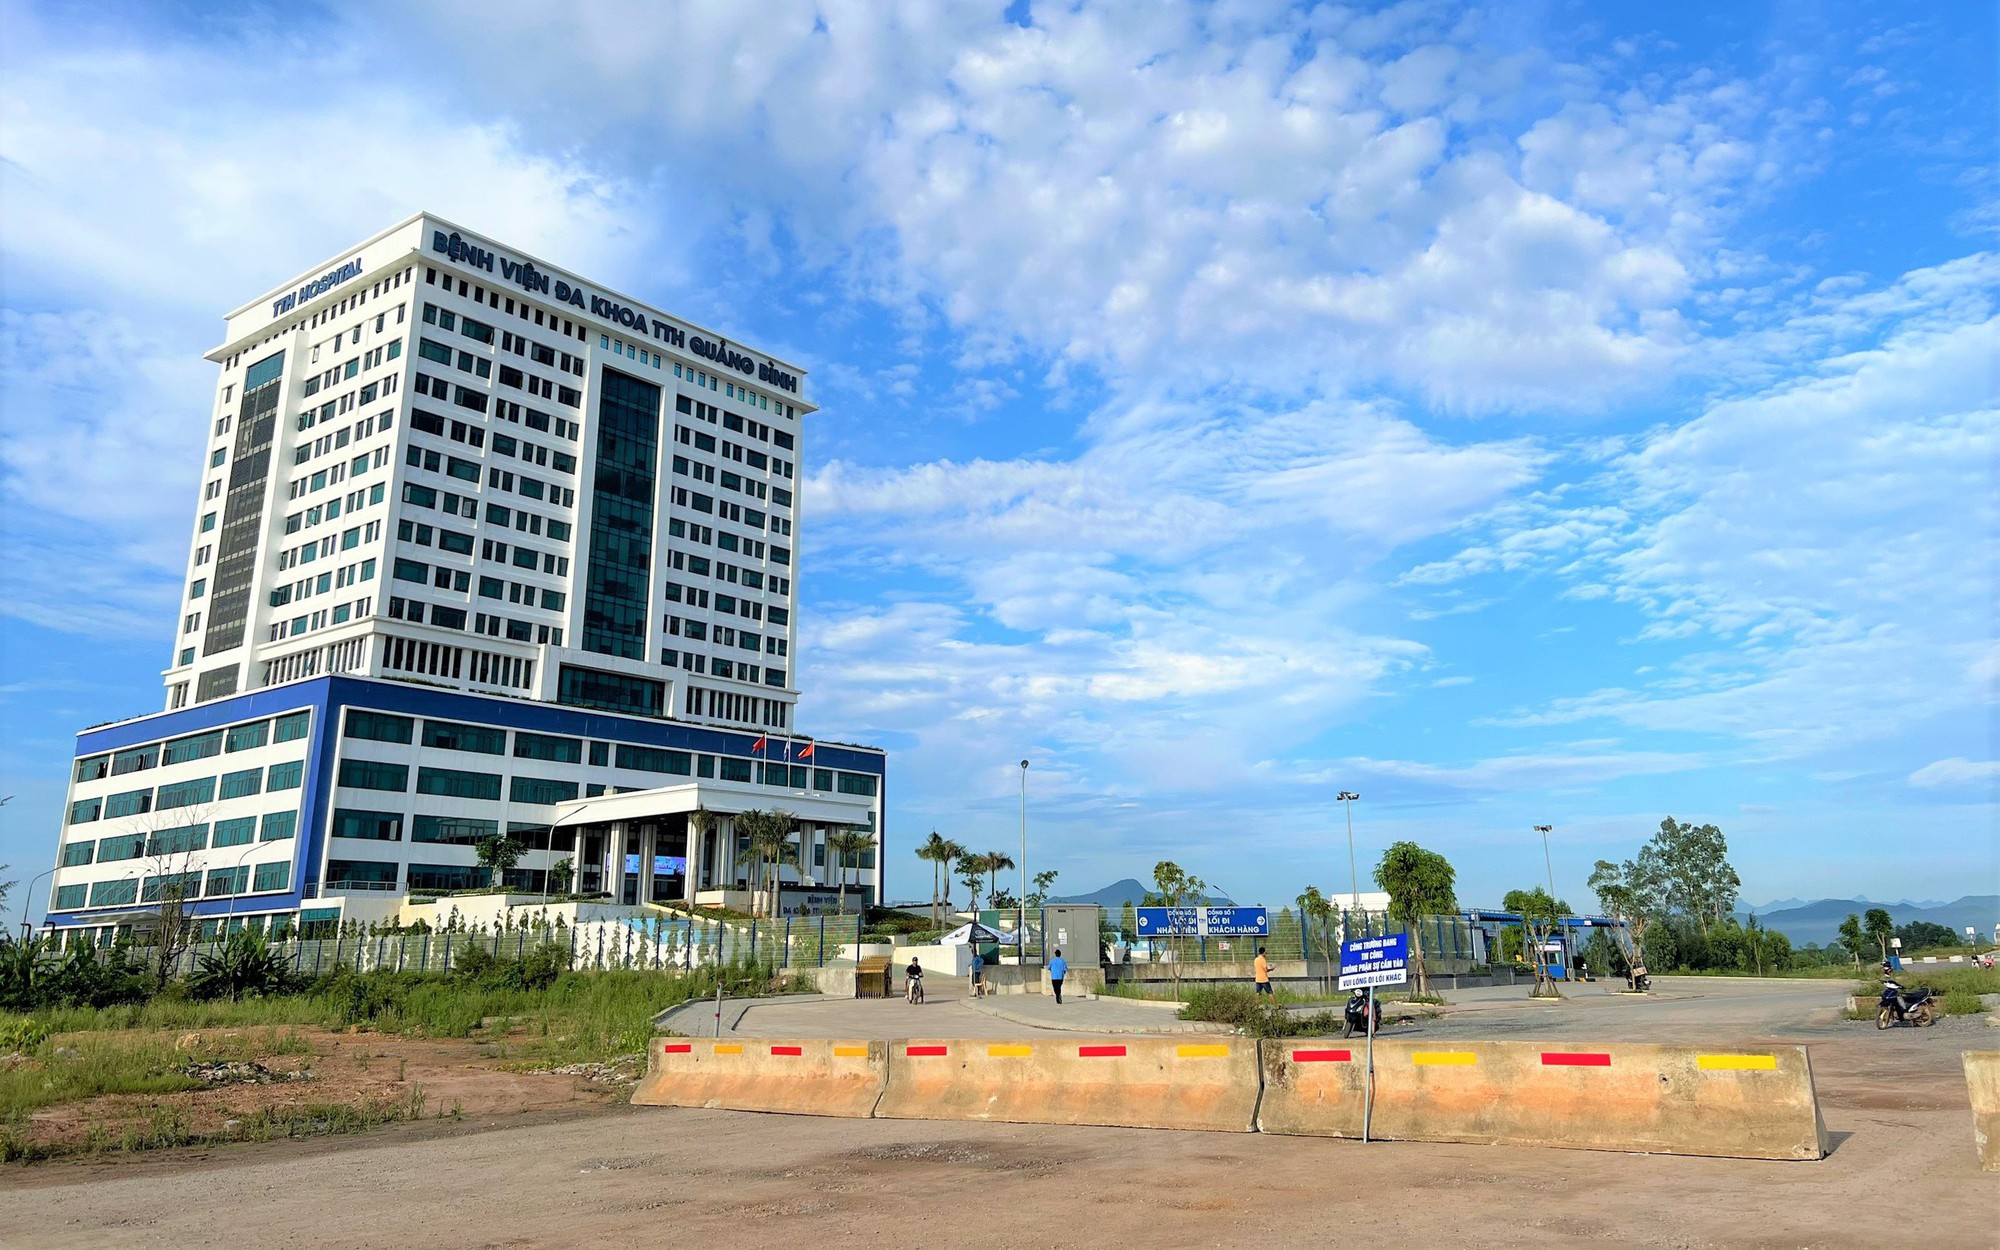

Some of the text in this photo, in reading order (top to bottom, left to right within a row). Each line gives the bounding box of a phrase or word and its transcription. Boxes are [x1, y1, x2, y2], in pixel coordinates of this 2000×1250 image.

[273, 258, 363, 318] TTH HOSPITAL
[433, 230, 797, 393] BỆNH VIỆN ĐA KHOA TTH QUẢNG BÌNH
[1208, 915, 1220, 924] LỐI
[1208, 924, 1260, 934] KHÁCH HÀNG
